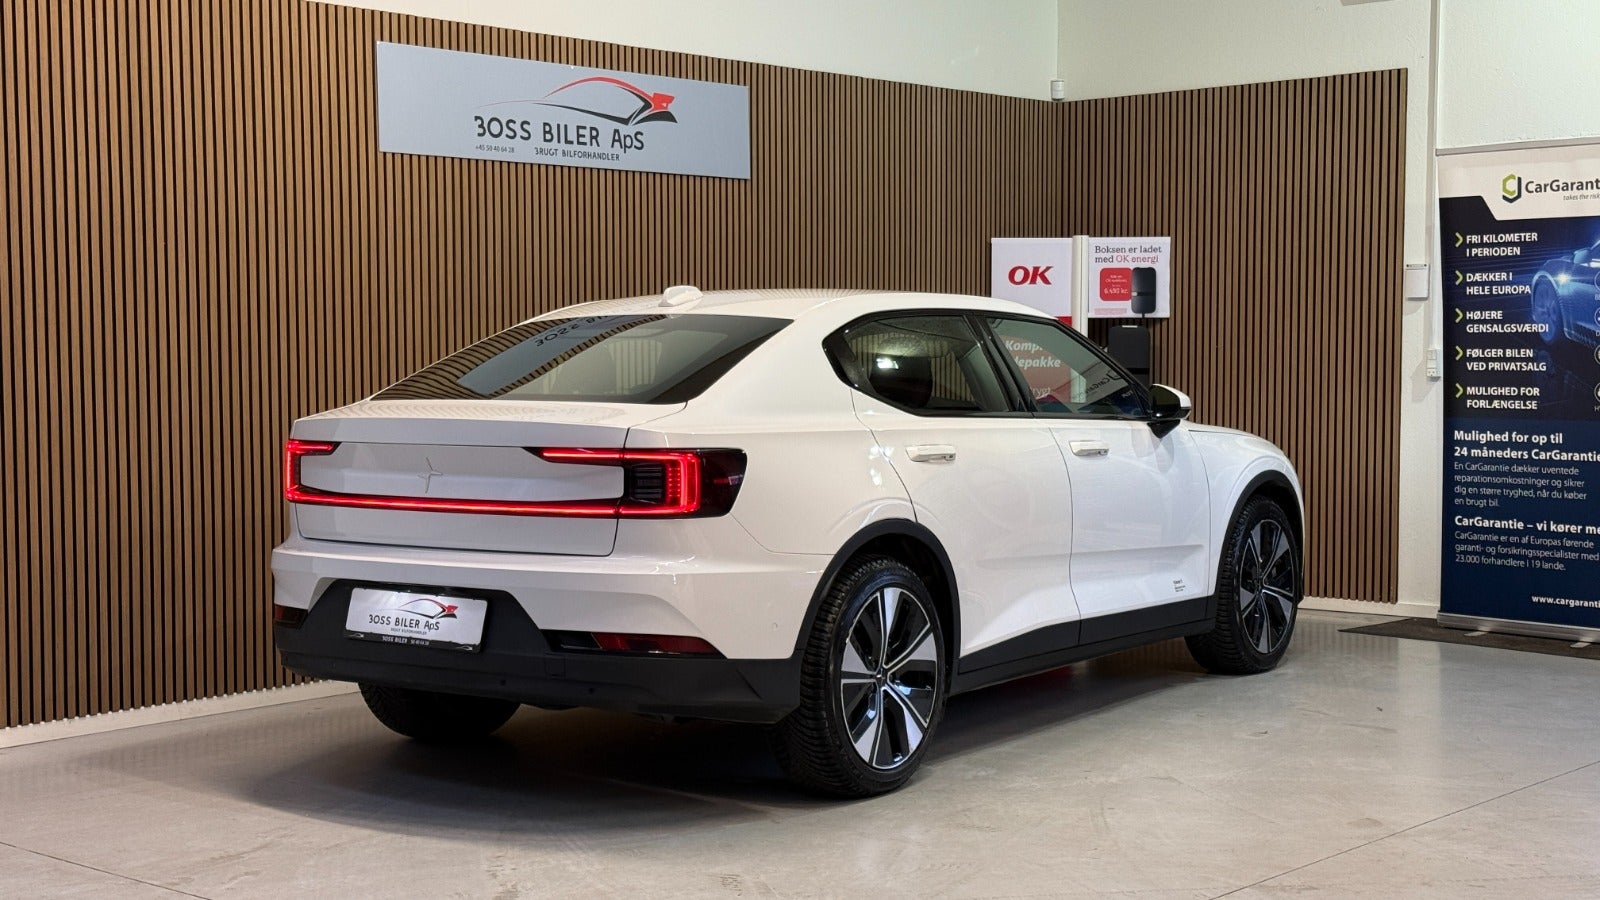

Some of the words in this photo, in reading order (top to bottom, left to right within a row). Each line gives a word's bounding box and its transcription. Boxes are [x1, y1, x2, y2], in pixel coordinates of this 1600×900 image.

[542, 122, 600, 147] BILER
[610, 128, 644, 154] ApS
[562, 149, 620, 161] BILFORHANDLER
[1466, 235, 1480, 244] FRI
[1483, 232, 1538, 243] KILOMETER
[1140, 245, 1162, 253] ladet
[1466, 248, 1469, 257] I
[1472, 247, 1520, 256] PERIODEN
[1132, 255, 1159, 264] energi
[1008, 266, 1054, 286] OK
[1466, 272, 1507, 282] DÆKKER
[1510, 272, 1512, 280] I
[1466, 286, 1490, 295] HELE
[1492, 286, 1531, 294] EUROPA
[1466, 311, 1503, 320] HØJERE
[1466, 324, 1548, 333] GENSALGSVÆRDI
[1005, 340, 1042, 354] Komp
[1466, 349, 1503, 358] FØLGER
[1506, 349, 1533, 358] BILEN
[1466, 362, 1486, 370] VED
[1488, 362, 1547, 371] PRIVATSALG
[1466, 387, 1518, 396] MULIGHED
[1520, 387, 1540, 396] FOR
[1466, 400, 1538, 409] FORLÆNGELSE
[1454, 430, 1508, 444] Mulighed
[1512, 432, 1529, 442] for
[1532, 434, 1547, 445] op
[1550, 433, 1563, 444] til
[1454, 447, 1468, 456] 24
[1471, 446, 1528, 459] måneders
[1454, 462, 1463, 470] En
[1465, 462, 1509, 472] CarGarantie
[1511, 464, 1540, 473] dækker
[1542, 466, 1580, 475] uventede
[1454, 474, 1549, 487] reparationsomkostninger
[1564, 479, 1584, 488] sikrer
[1454, 485, 1466, 495] dig
[1480, 487, 1502, 495] større
[1503, 488, 1535, 498] tryghed,
[1537, 489, 1549, 497] når
[1551, 489, 1561, 498] du
[1564, 491, 1587, 500] køber
[1466, 497, 1487, 508] brugt
[1489, 498, 1498, 506] bil.
[1455, 516, 1524, 529] CarGarantie
[1536, 521, 1547, 531] vi
[1551, 521, 1582, 533] kører
[1455, 531, 1499, 541] CarGarantie
[1521, 535, 1529, 543] af
[1530, 536, 1561, 546] Europas
[1563, 538, 1594, 548] førende
[1455, 544, 1484, 552] garanti-
[1486, 546, 1496, 555] og
[1498, 545, 1579, 559] forsikringsspecialister
[1455, 554, 1479, 563] 23.000
[1481, 555, 1525, 567] forhandlere
[1542, 561, 1566, 570] lande.
[394, 617, 420, 629] BILER
[424, 620, 440, 632] ApS
